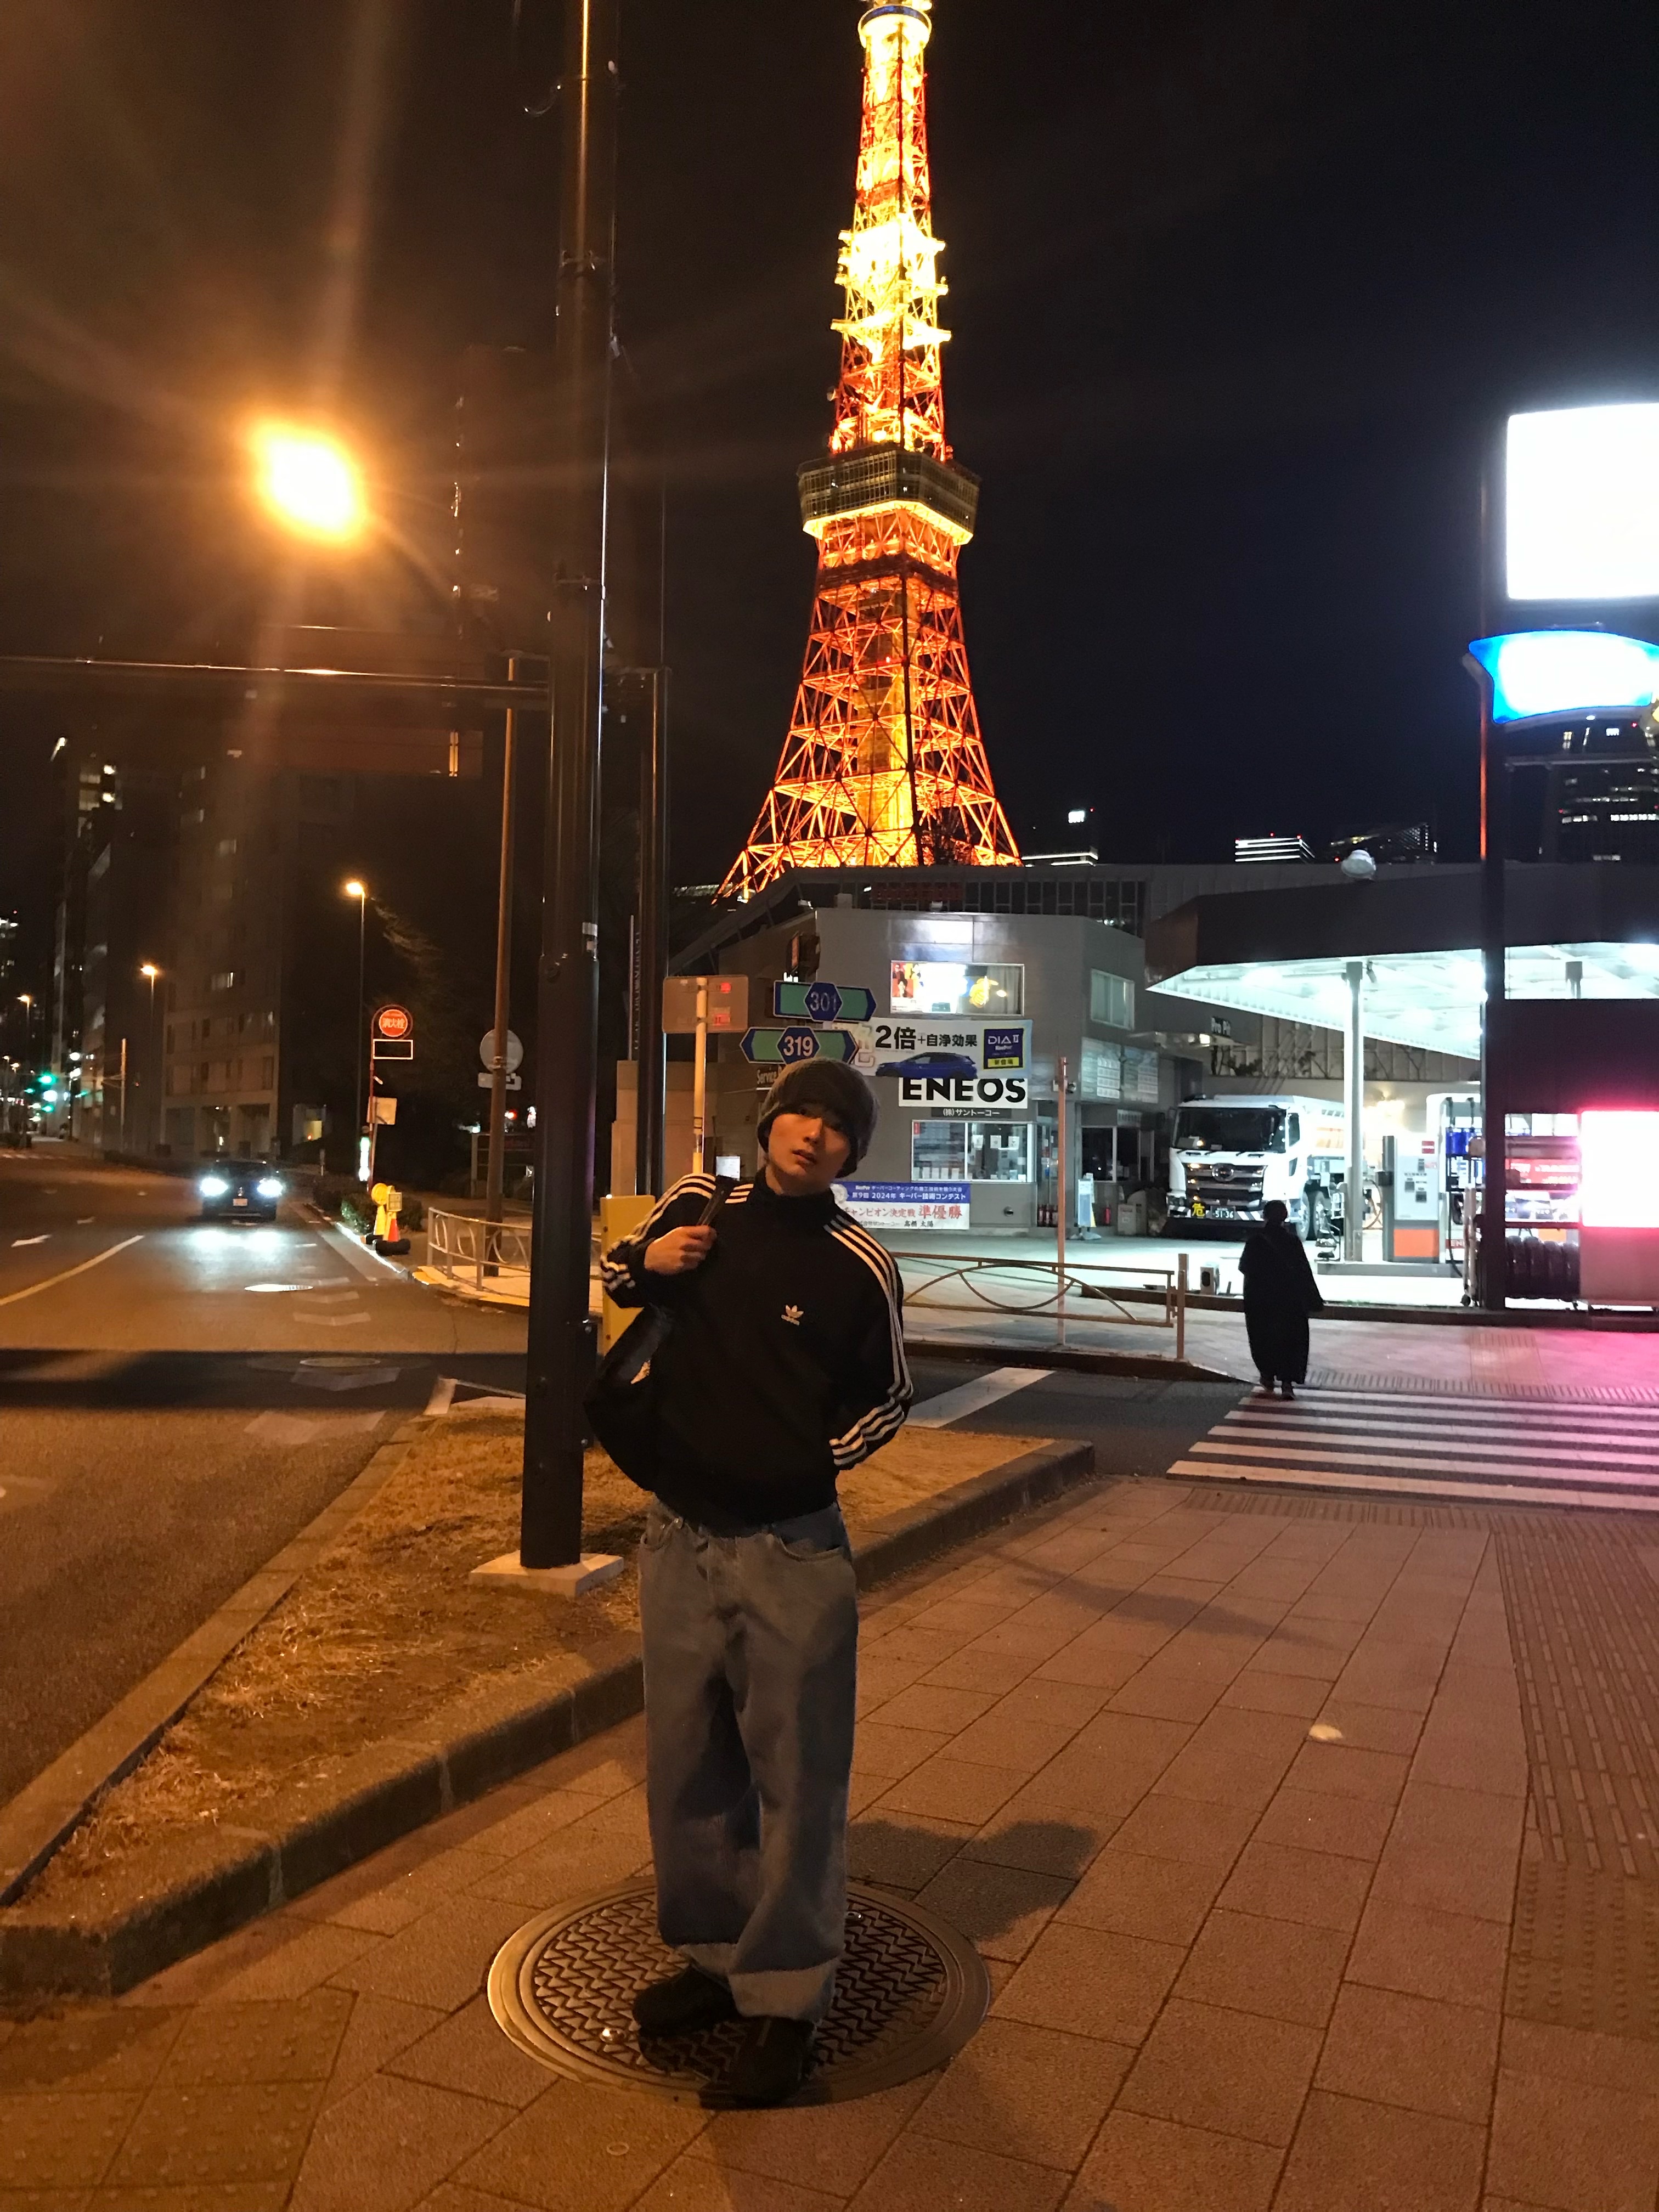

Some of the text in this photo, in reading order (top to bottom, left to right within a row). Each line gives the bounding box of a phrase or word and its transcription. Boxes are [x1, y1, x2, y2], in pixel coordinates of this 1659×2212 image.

[810, 991, 837, 1012] 301
[783, 1035, 814, 1057] 319
[902, 1077, 1026, 1103] ENEOS
[1192, 1202, 1206, 1218] 危
